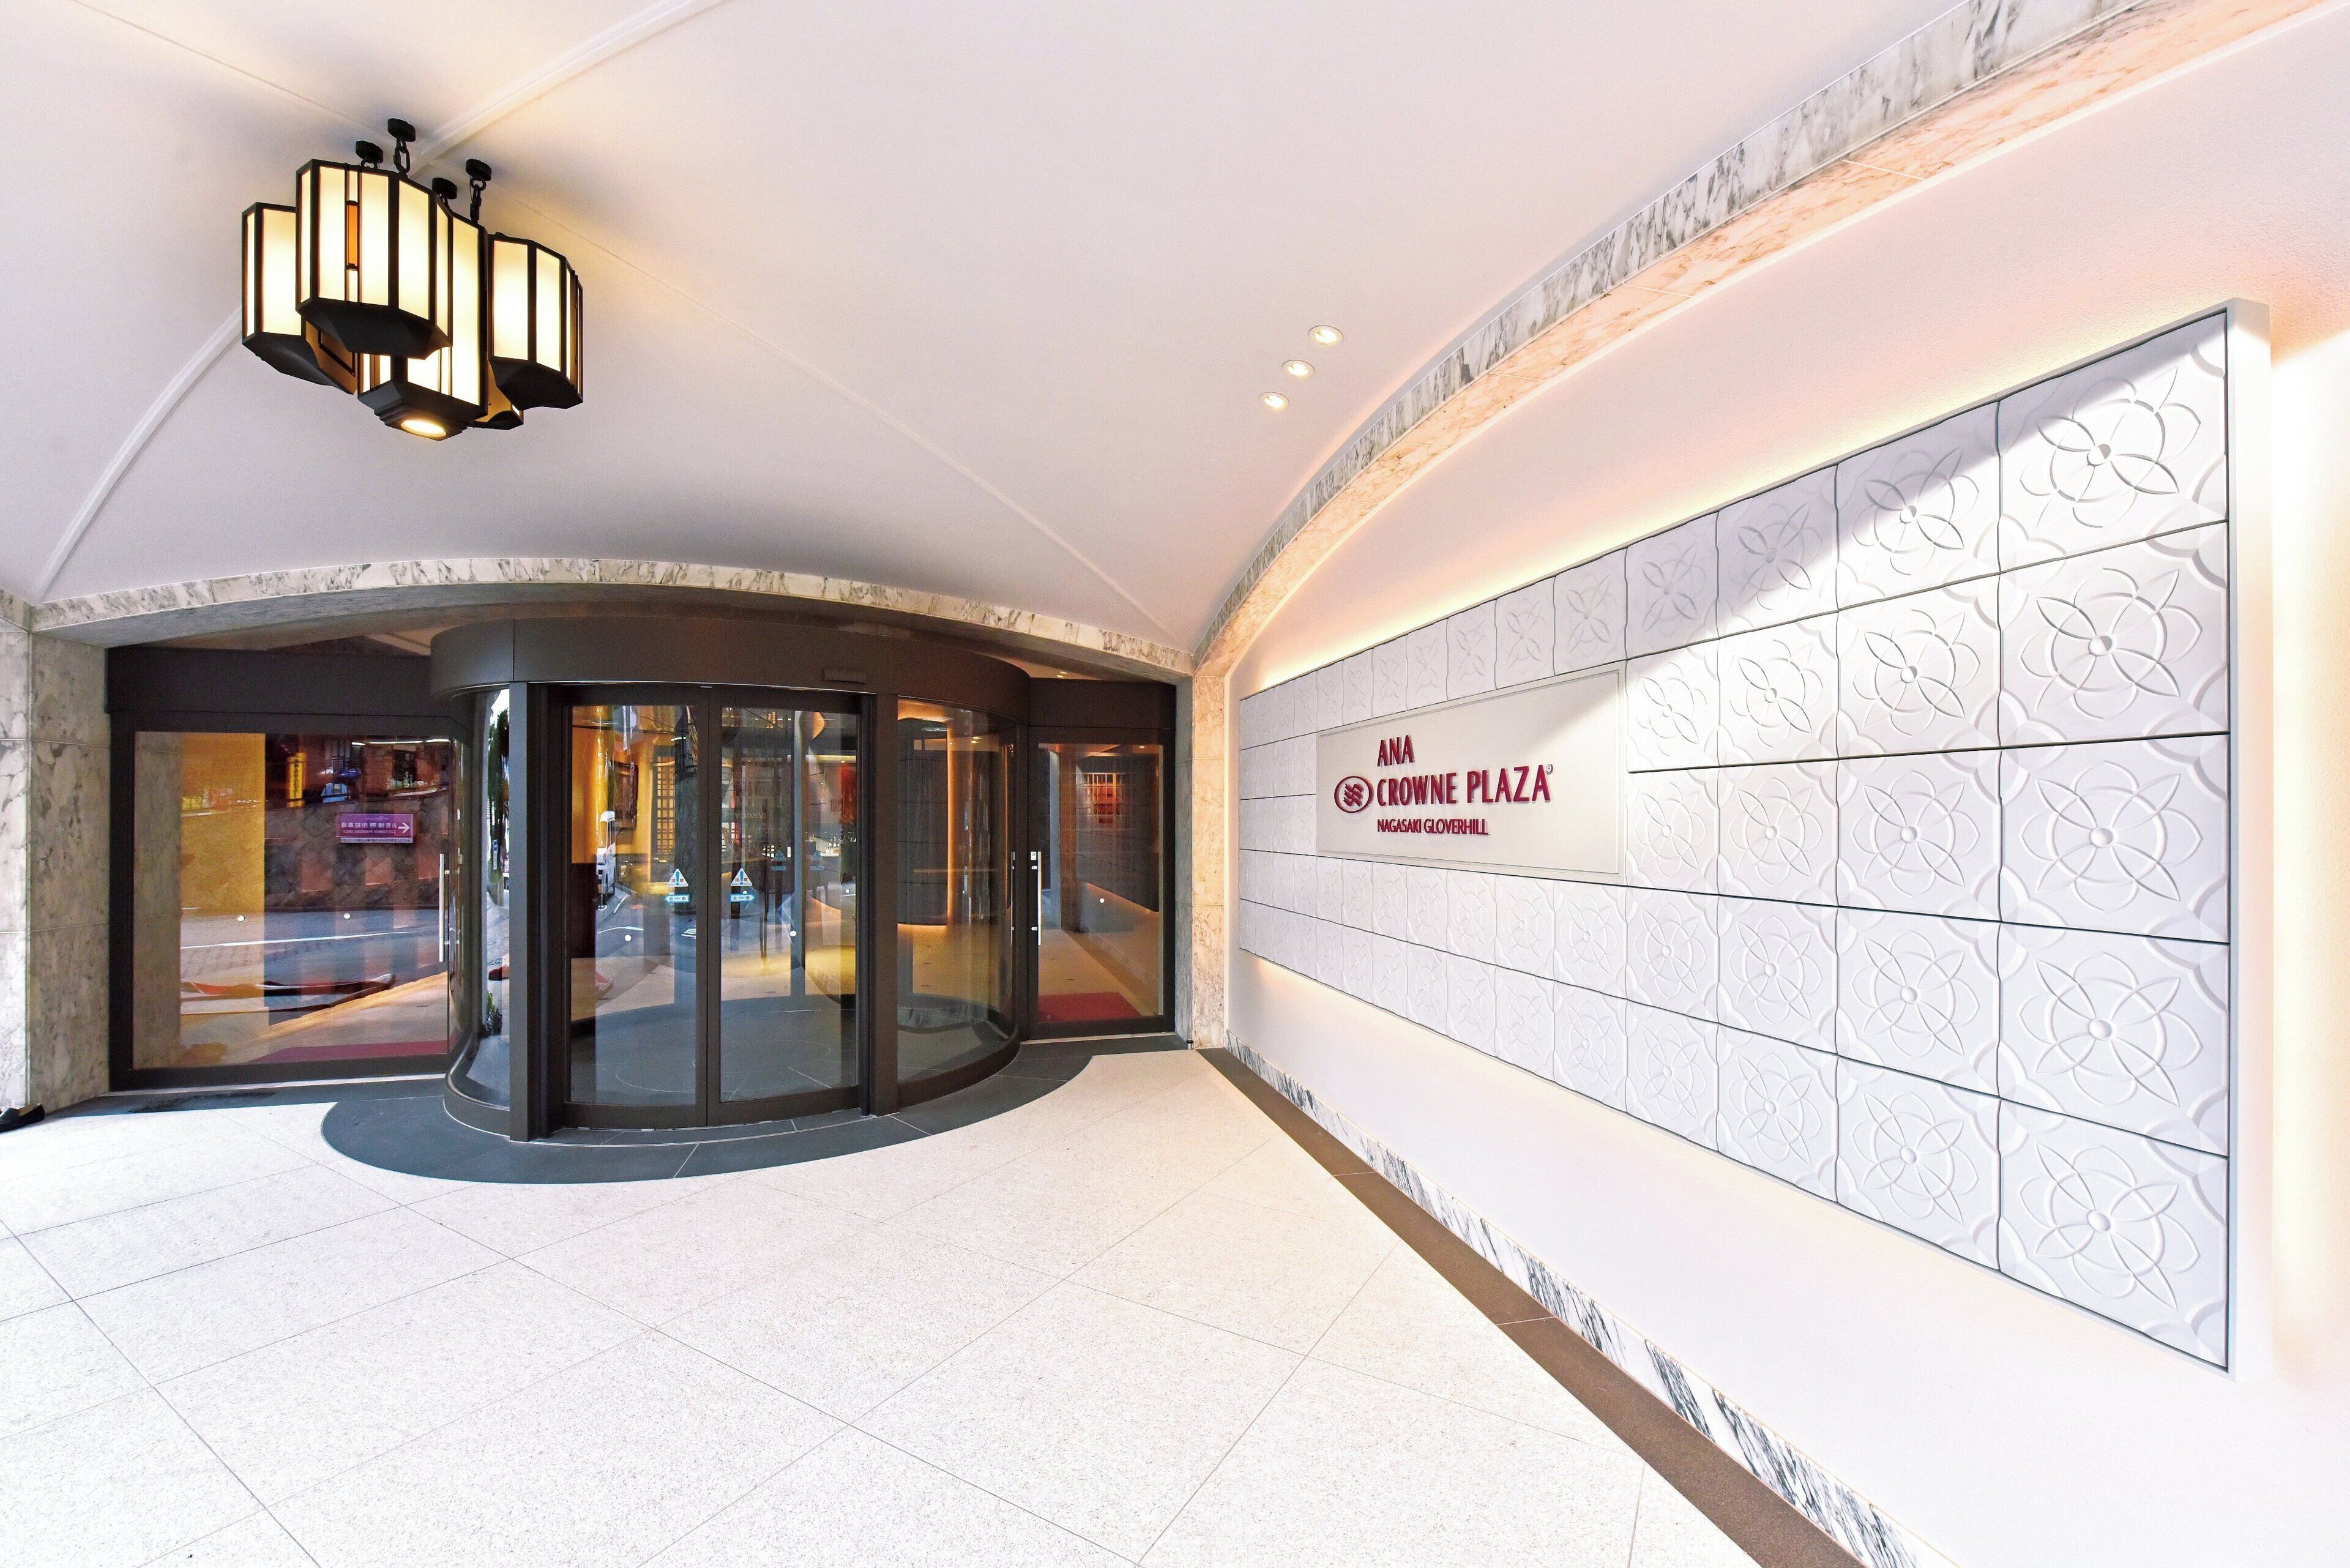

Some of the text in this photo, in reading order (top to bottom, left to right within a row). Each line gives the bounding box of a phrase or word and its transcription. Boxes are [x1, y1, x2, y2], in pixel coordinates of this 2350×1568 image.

[1377, 735, 1414, 766] ANA
[1377, 772, 1457, 806] CROWNE
[1377, 819, 1488, 835] NAGASAKI GLOVERHILL
